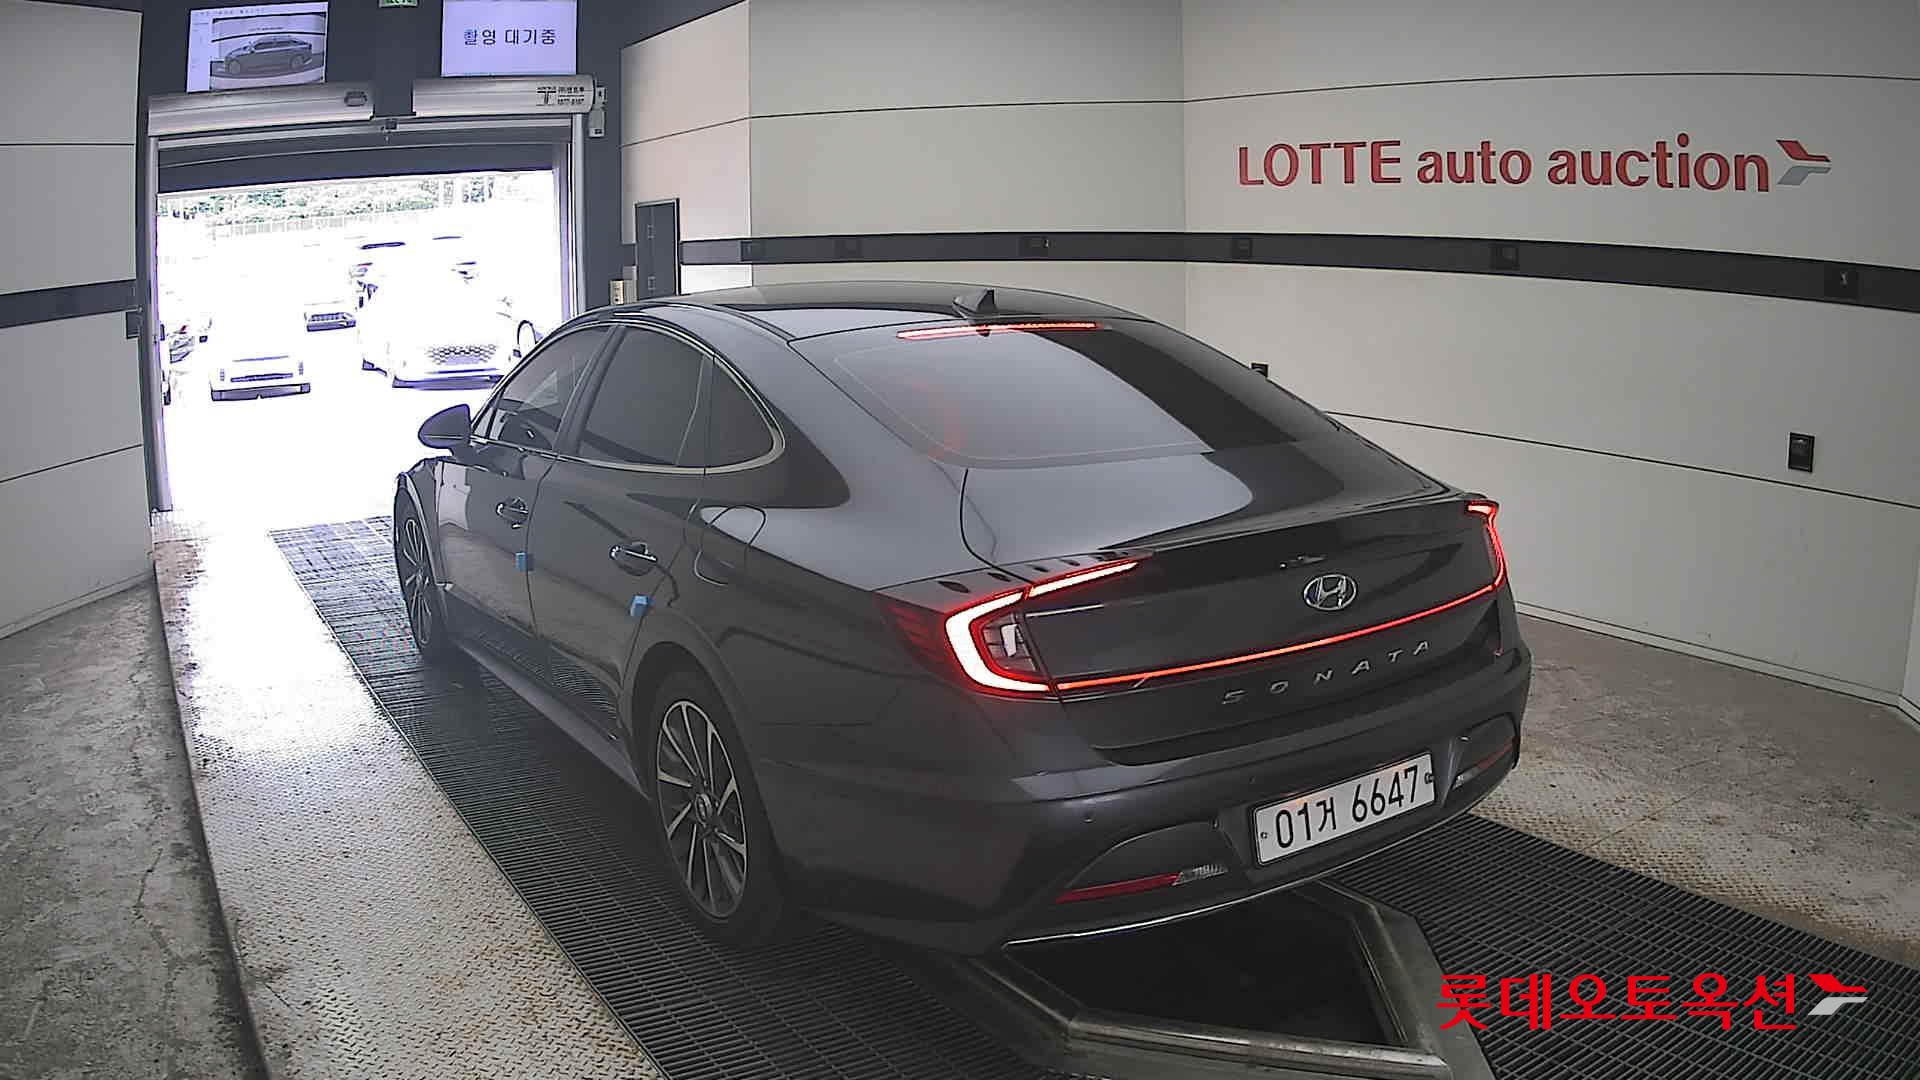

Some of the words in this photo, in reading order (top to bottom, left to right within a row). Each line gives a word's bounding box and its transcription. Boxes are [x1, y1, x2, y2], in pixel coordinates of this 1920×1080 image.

[505, 28, 556, 46] 대기중
[1238, 140, 1401, 187] LOTTE
[1416, 140, 1532, 185] auto
[1547, 132, 1769, 192] auction
[1221, 640, 1429, 705] SONATA
[1275, 796, 1337, 849] 01거
[1352, 765, 1418, 823] 6647
